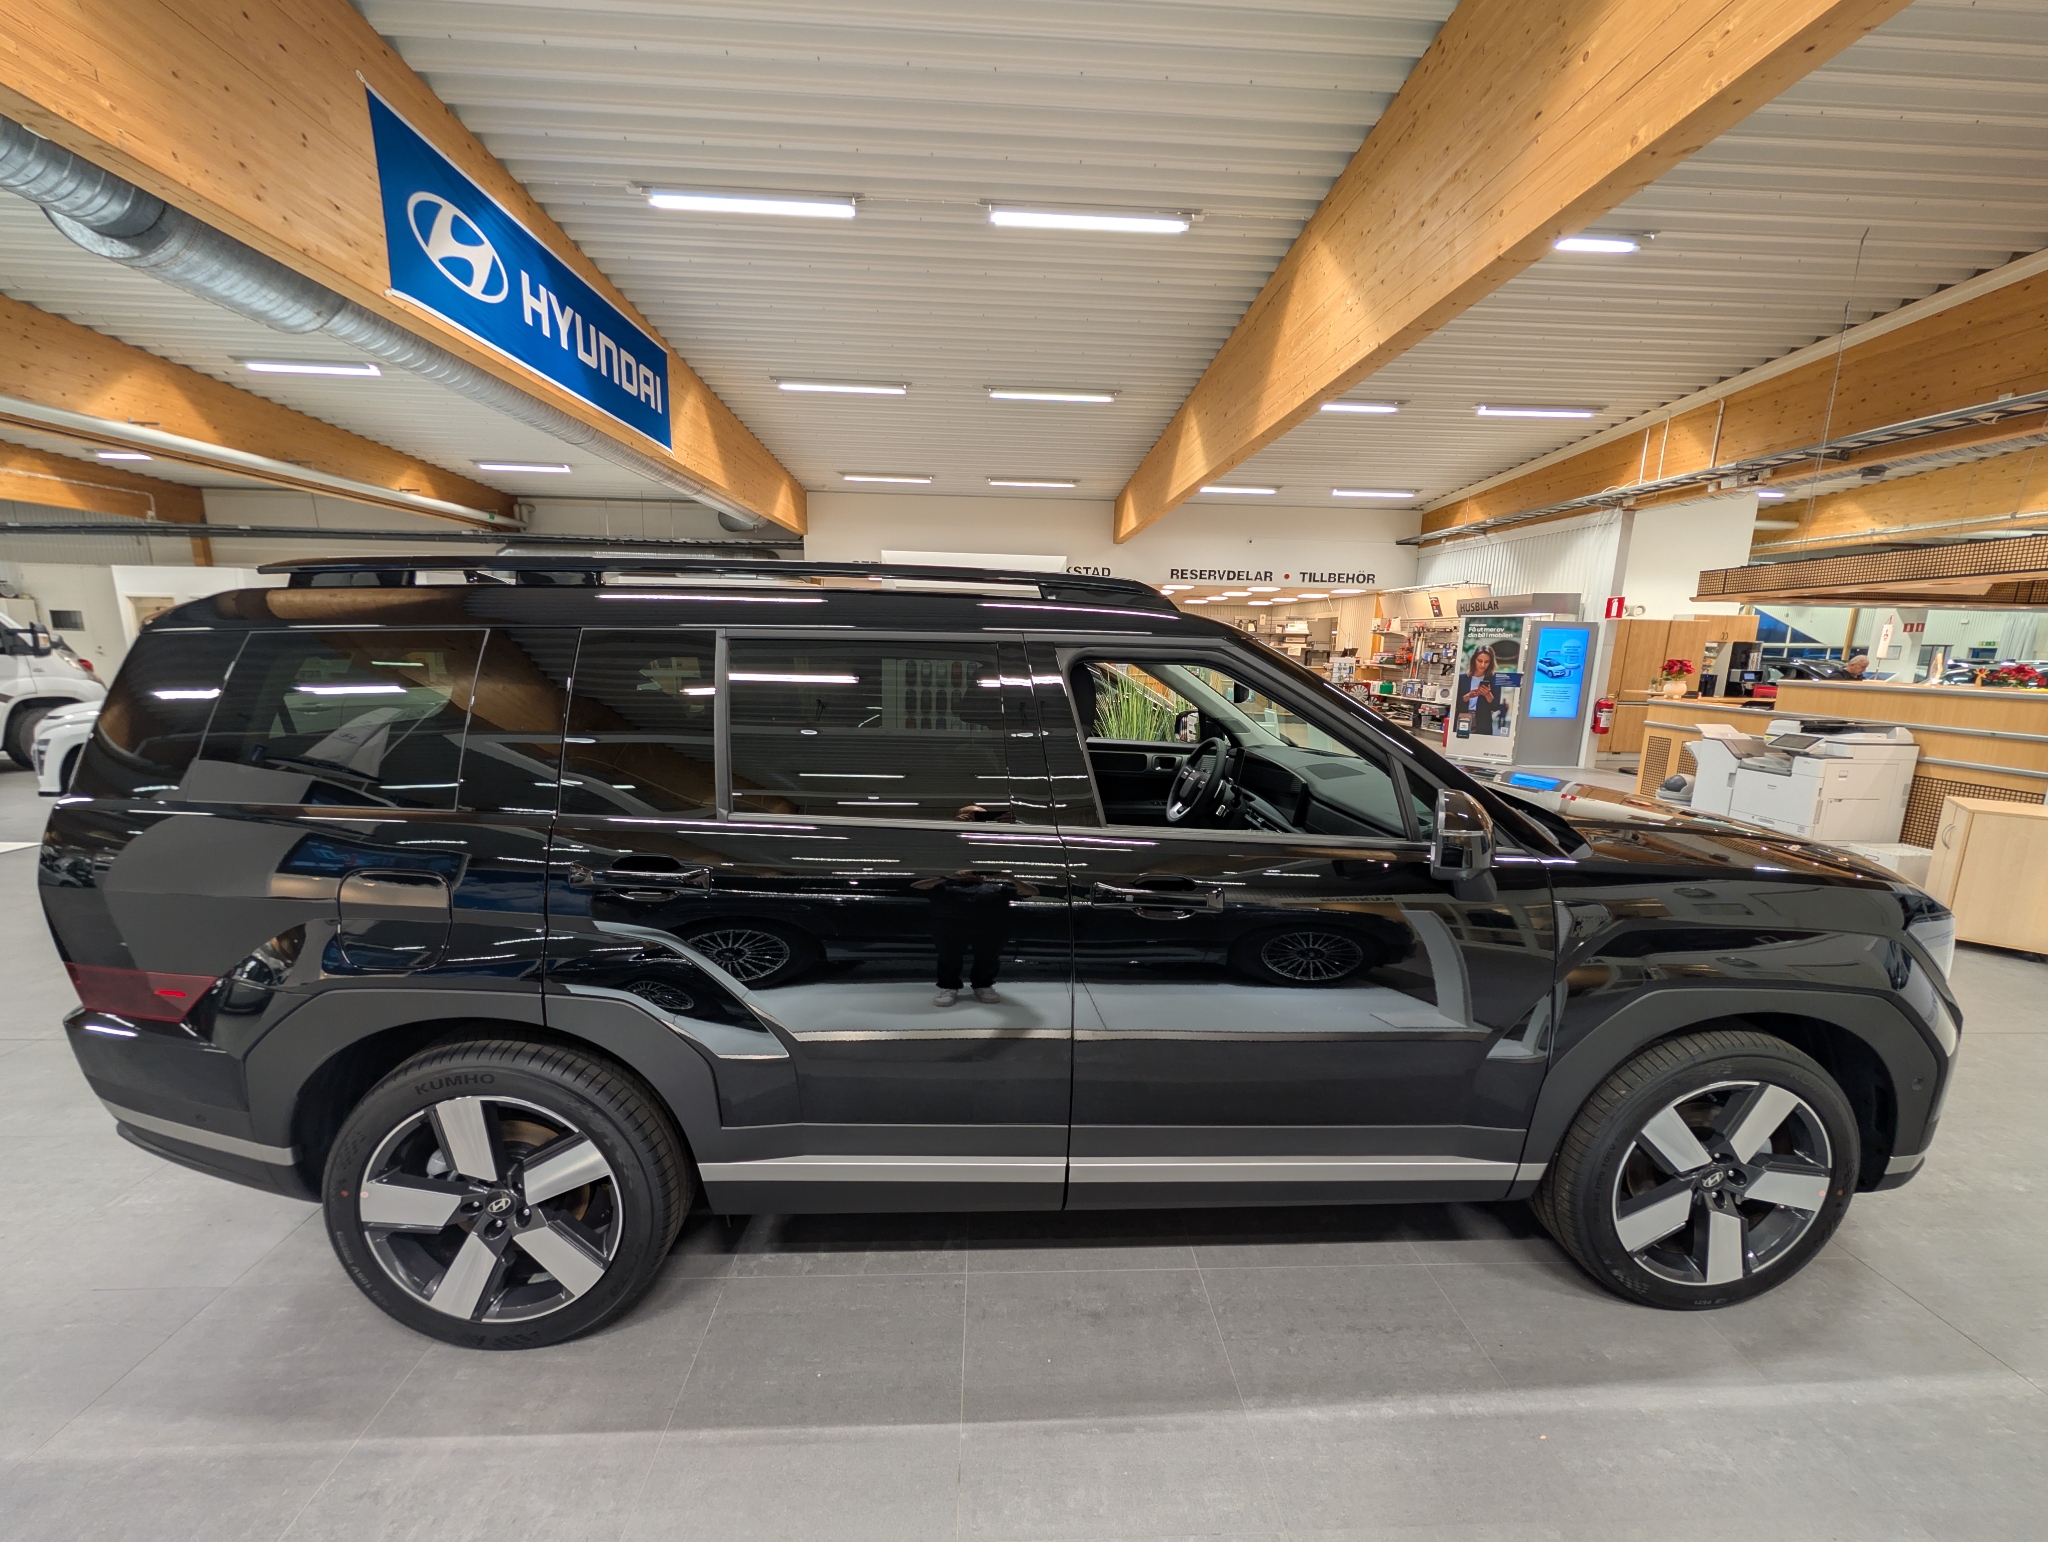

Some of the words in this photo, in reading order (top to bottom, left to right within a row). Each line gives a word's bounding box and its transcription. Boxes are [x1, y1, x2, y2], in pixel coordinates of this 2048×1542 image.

[520, 269, 663, 414] HYUNDAI
[1170, 568, 1273, 582] RESERVDELAR
[1300, 570, 1376, 584] TILLBEHÖR
[1460, 600, 1499, 613] HUSBILAR
[415, 1073, 495, 1095] KUMHO
